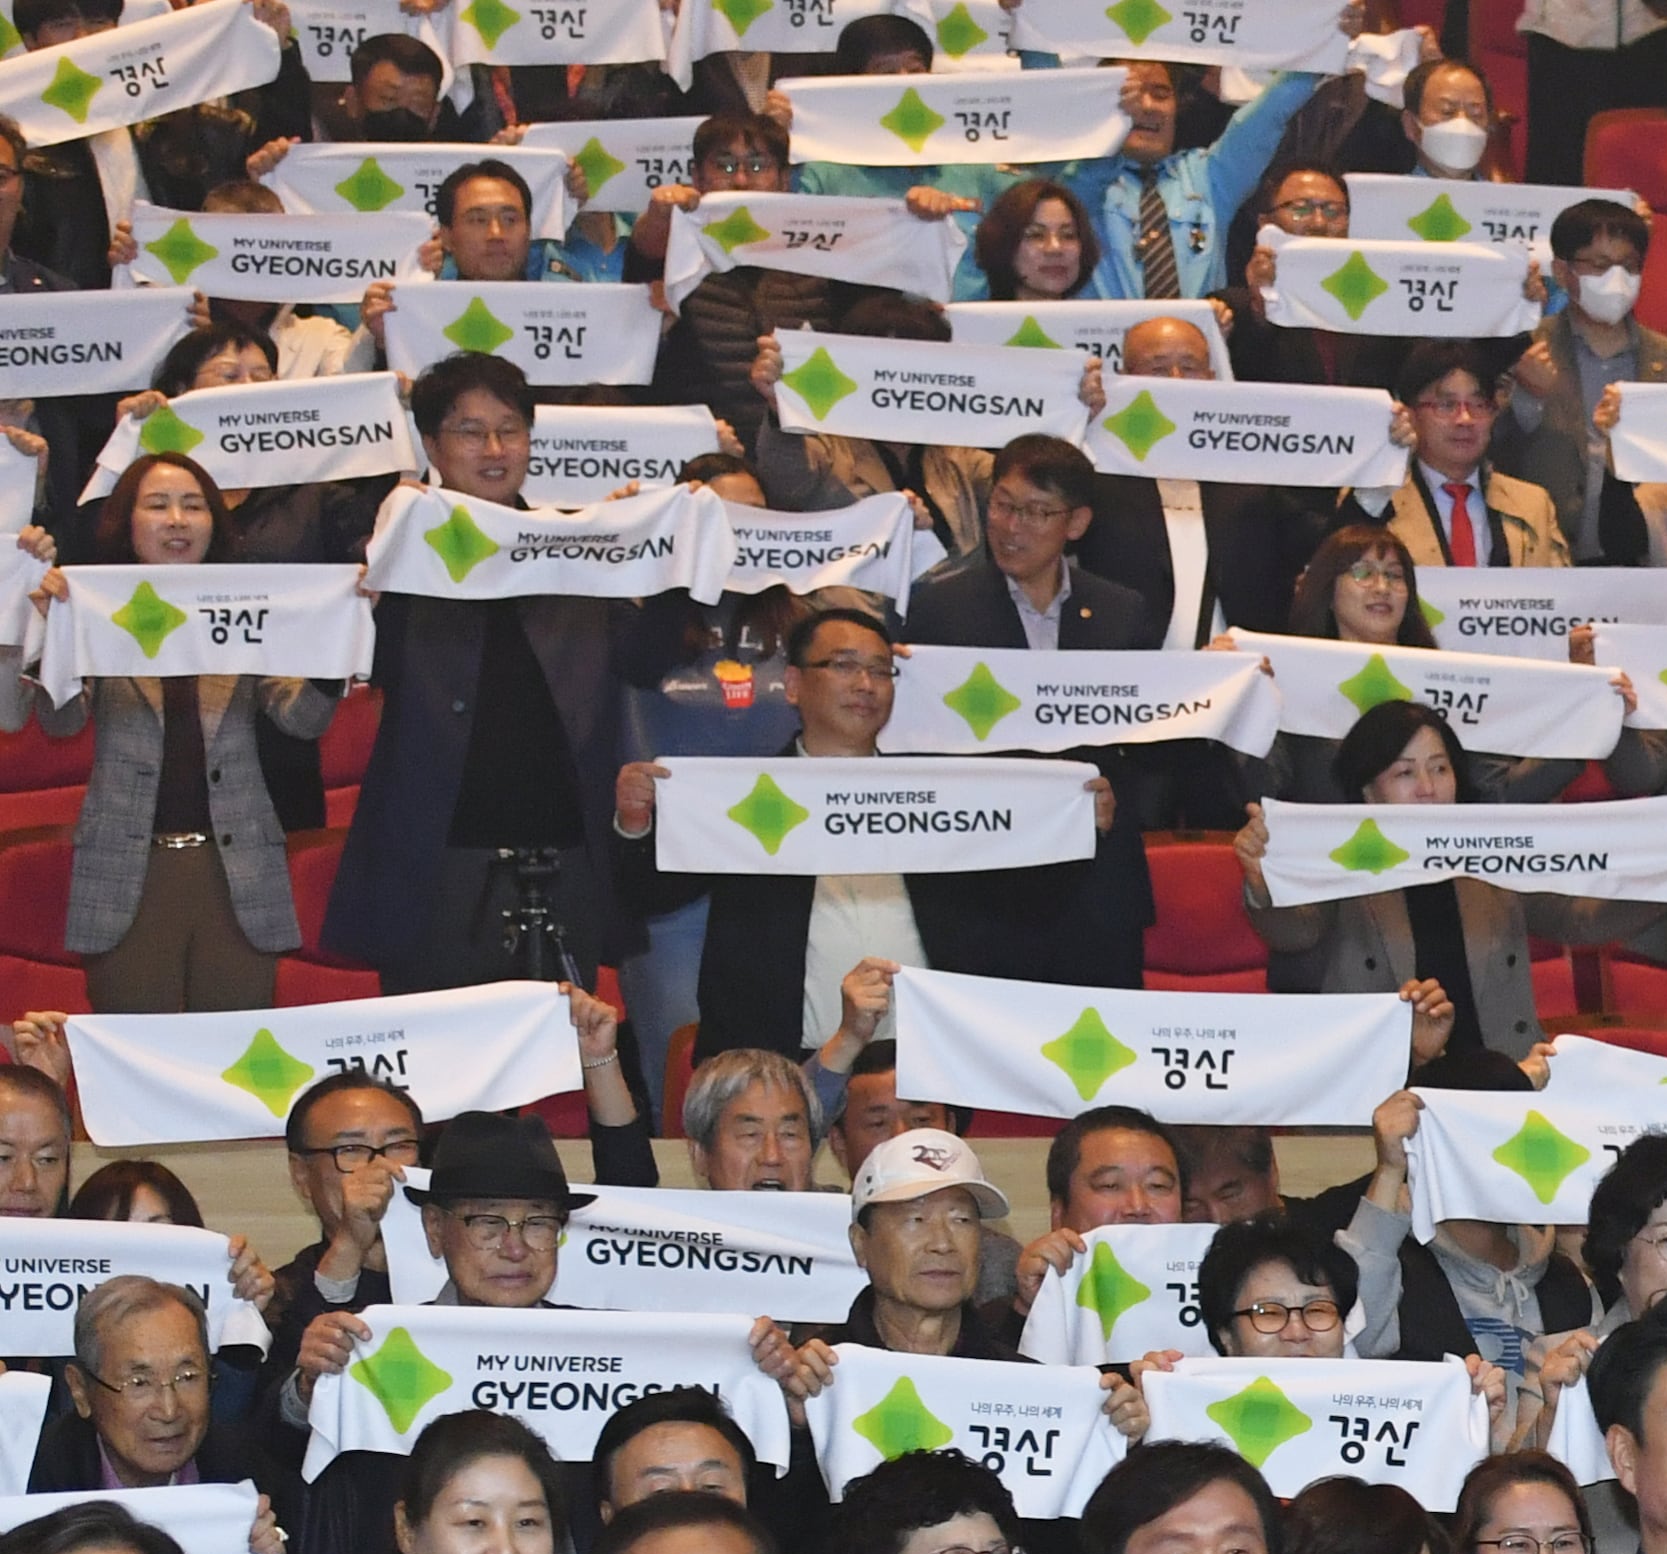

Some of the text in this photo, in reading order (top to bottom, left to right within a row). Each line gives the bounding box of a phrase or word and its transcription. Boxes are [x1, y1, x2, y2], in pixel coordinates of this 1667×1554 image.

[536, 9, 586, 40] 경산
[1183, 12, 1241, 44] 경산
[109, 57, 170, 97] 경산
[954, 111, 1011, 142] 경산
[234, 238, 331, 252] MY UNIVERSE
[232, 254, 395, 278] GYEONGSAN
[1399, 280, 1458, 312] 경산
[524, 326, 586, 359] 경산
[875, 370, 975, 387] MY UNIVERSE
[872, 386, 1043, 416] GYEONGSAN
[219, 410, 322, 426] MY UNIVERSE
[219, 419, 392, 453] GYEONGSAN
[199, 609, 269, 644] 경산
[1037, 685, 1138, 697] MY UNIVERSE
[1035, 700, 1210, 725] GYEONGSAN
[827, 791, 936, 805] MY UNIVERSE
[825, 810, 1011, 835] GYEONGSAN
[1152, 1048, 1234, 1089] 경산
[477, 1355, 622, 1372] MY UNIVERSE
[966, 1425, 1060, 1478] 경산
[1329, 1415, 1420, 1466] 경산
